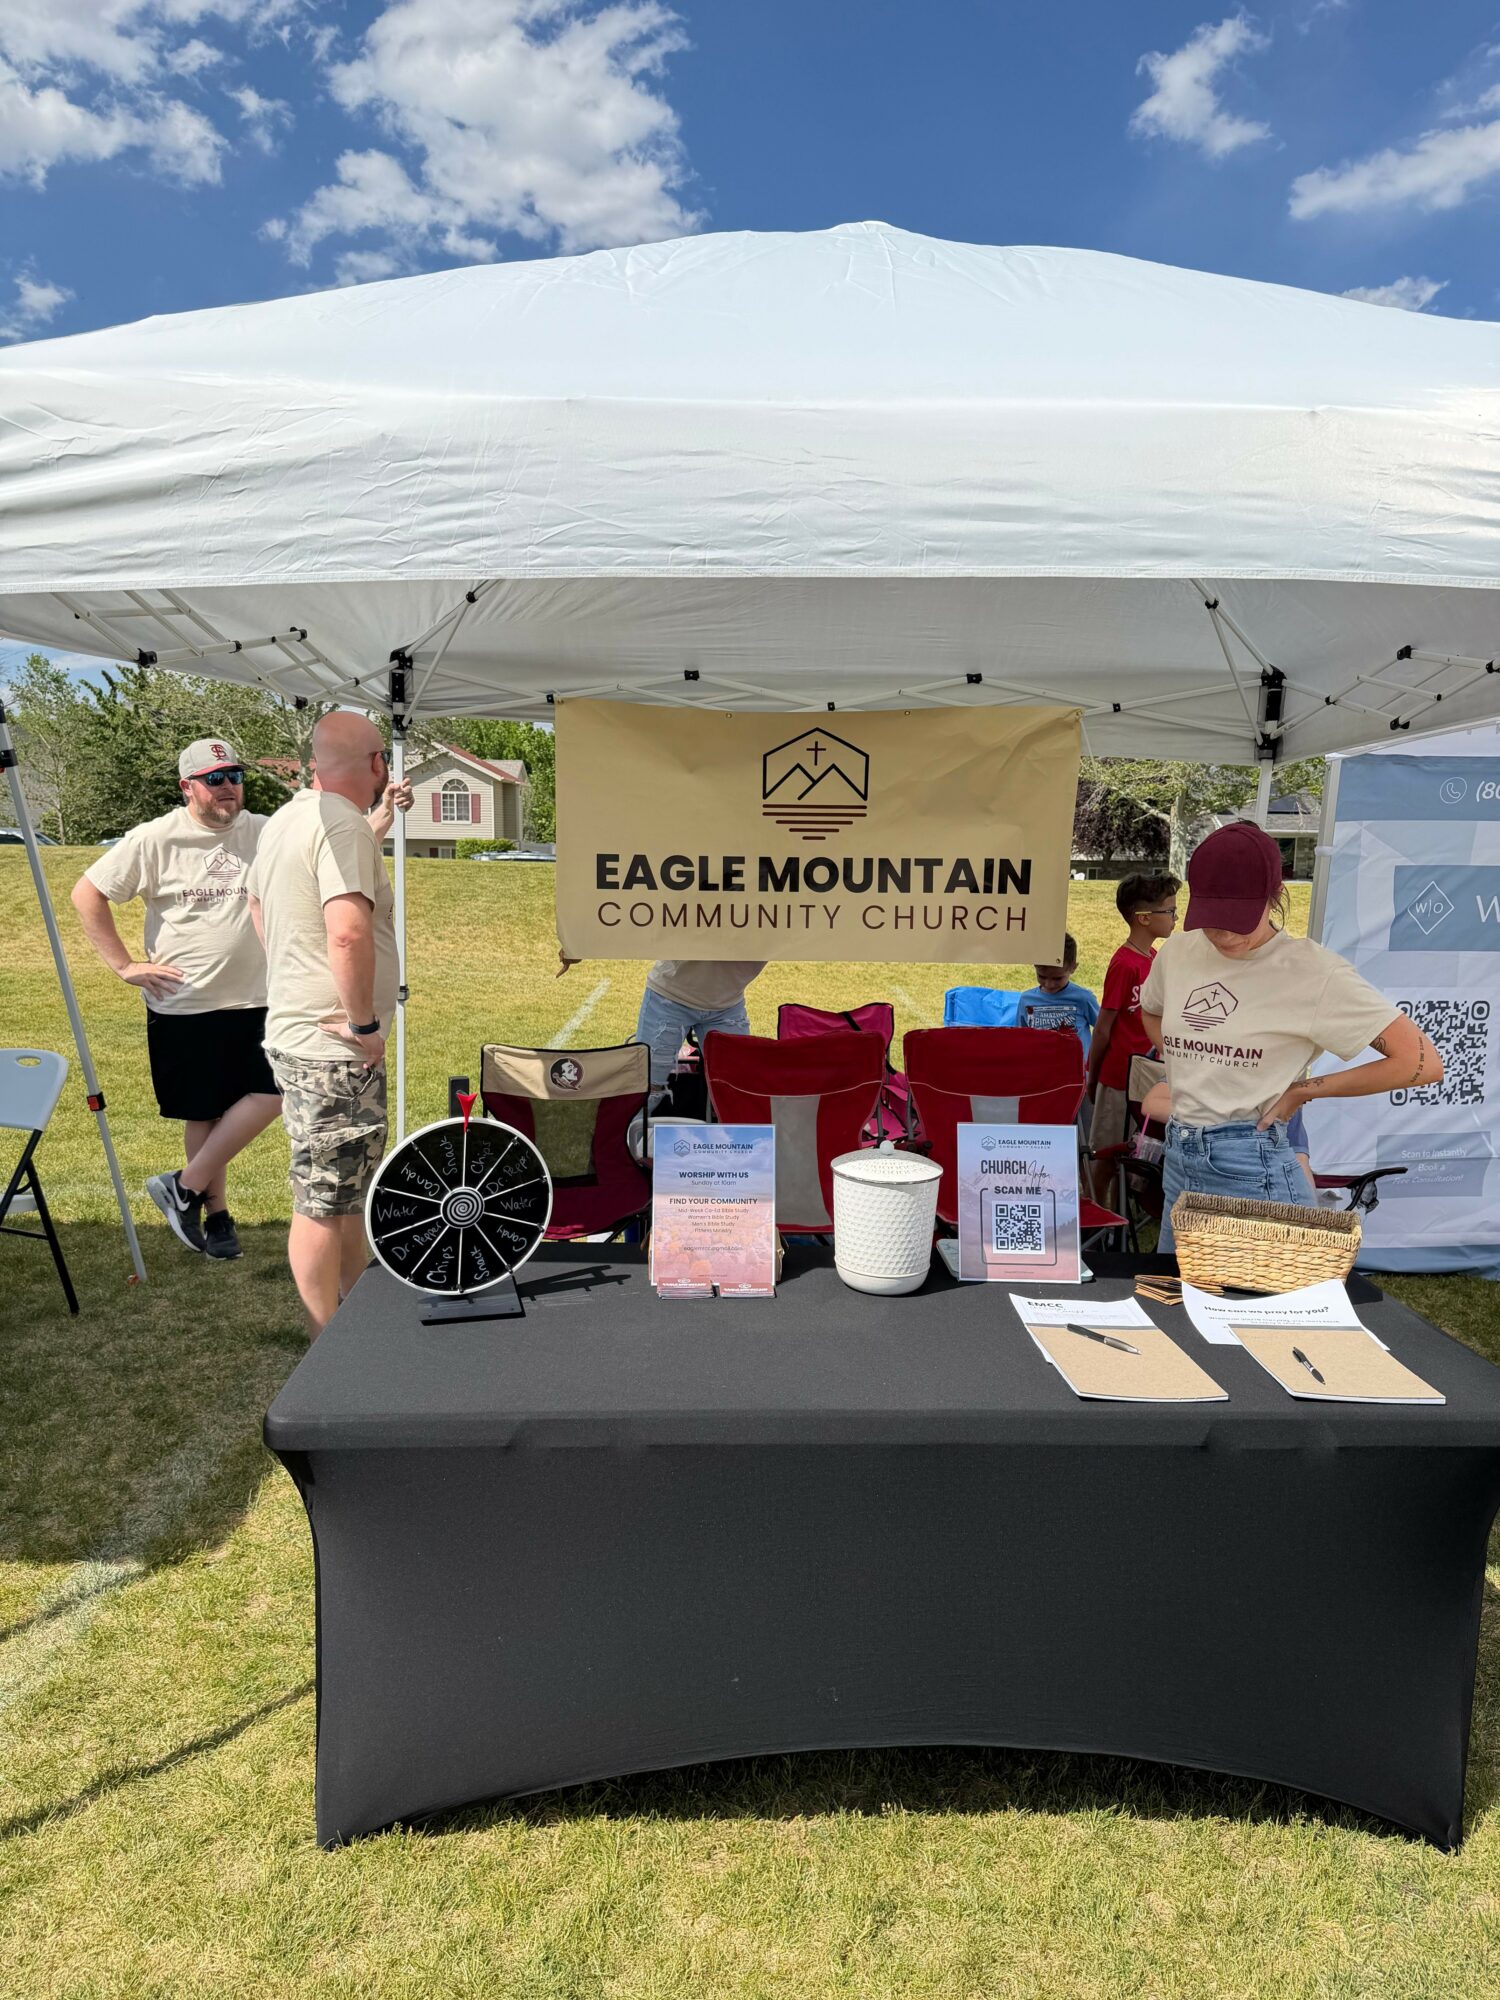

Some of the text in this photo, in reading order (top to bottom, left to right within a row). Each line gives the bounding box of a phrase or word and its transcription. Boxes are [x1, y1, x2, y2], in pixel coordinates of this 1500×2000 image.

[596, 853, 1032, 895] EAGLE MOUNTAIN
[182, 888, 214, 897] EAGLE
[597, 901, 1027, 932] COMMUNITY CHURCH
[1183, 1039, 1263, 1060] MOUNTAIN
[1209, 1056, 1259, 1068] CHURCH
[440, 1135, 458, 1176] Snack
[470, 1140, 494, 1174] Chips
[1401, 1148, 1467, 1159] Scan to Instantly
[485, 1150, 530, 1195] Dr. Pepper
[679, 1171, 749, 1179] WORSHIP WITH US
[980, 1159, 1027, 1175] CHURCH
[1418, 1163, 1437, 1172] Book
[400, 1162, 441, 1197] Candy
[994, 1186, 1042, 1195] SCAN ME
[376, 1202, 418, 1223] Water
[500, 1197, 537, 1211] Water
[391, 1220, 443, 1261] Dr. Pepper
[496, 1224, 528, 1252] Candy
[426, 1245, 455, 1284] Chips
[470, 1245, 490, 1281] Snack
[1305, 1306, 1329, 1315] you?
